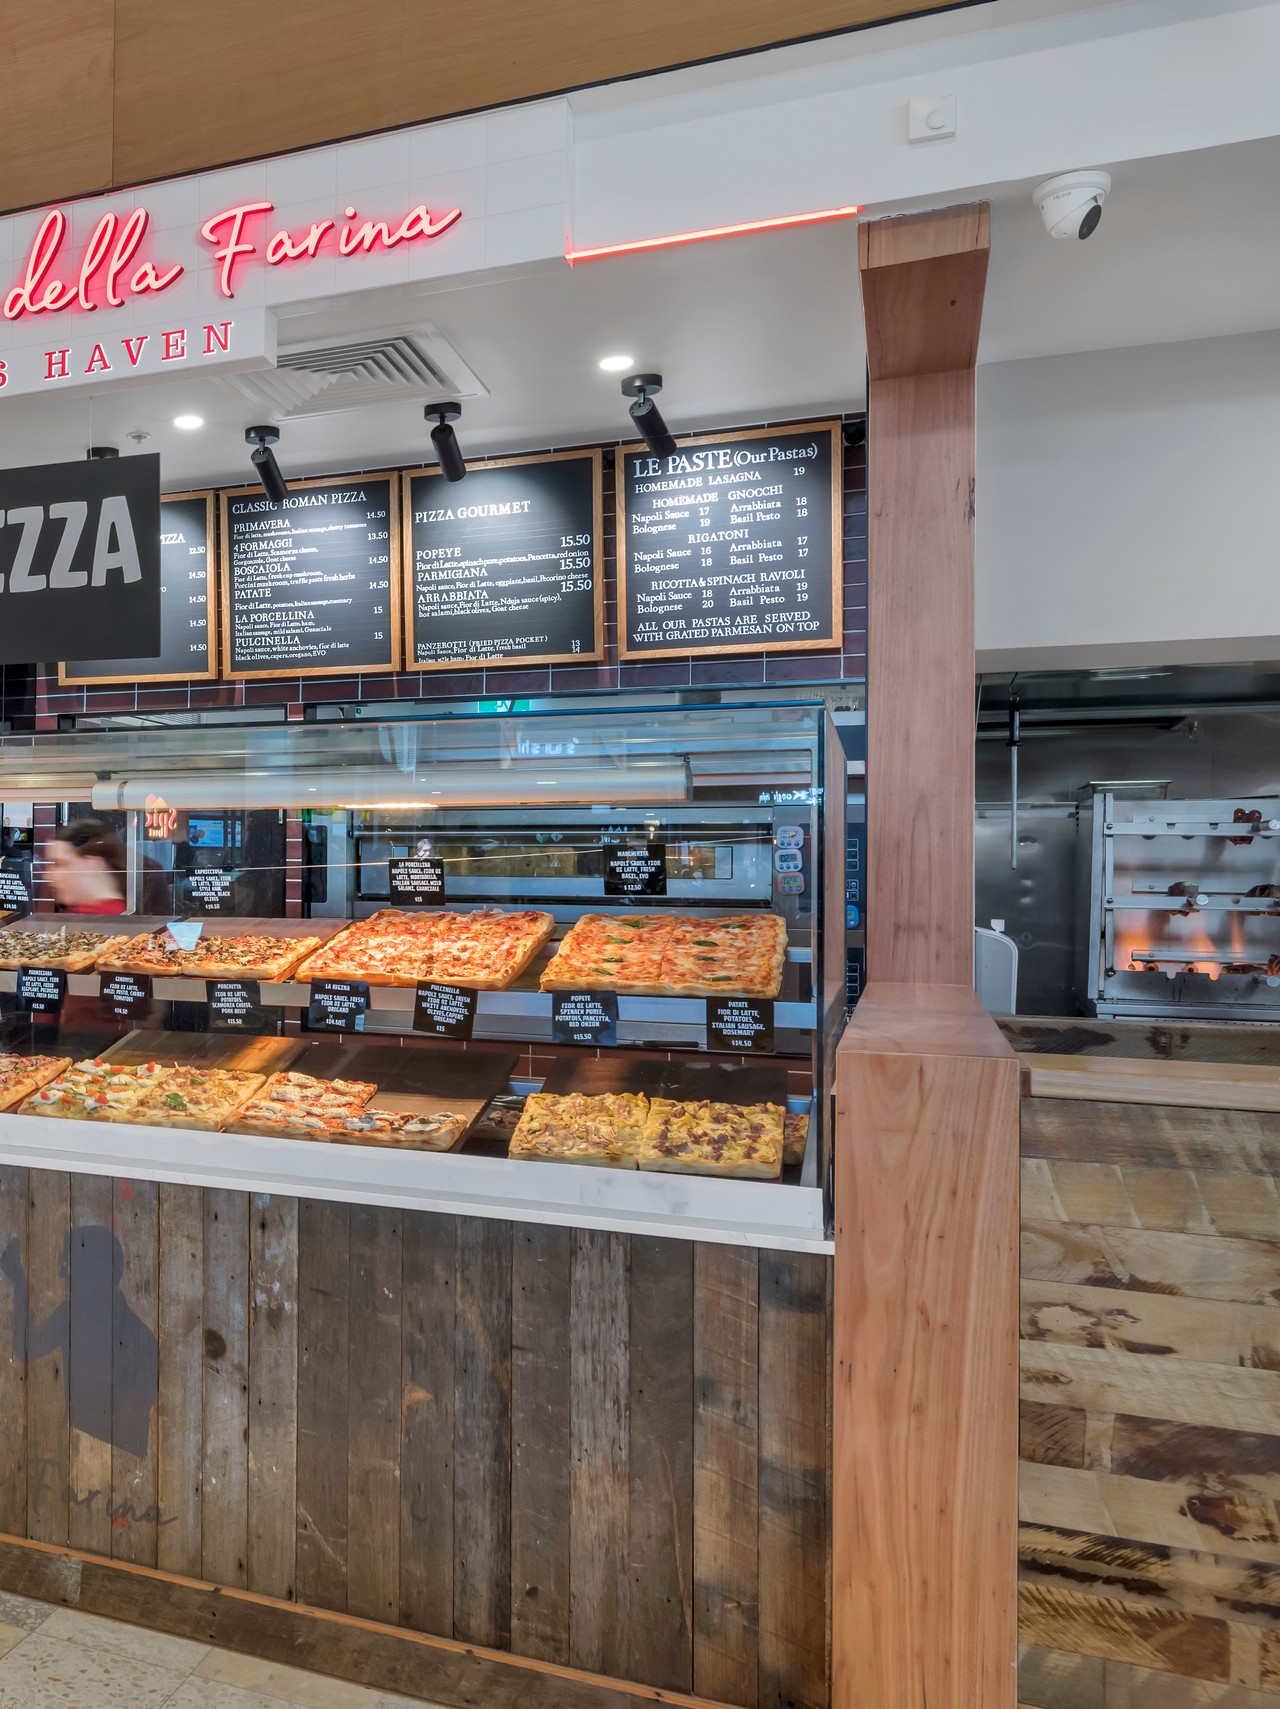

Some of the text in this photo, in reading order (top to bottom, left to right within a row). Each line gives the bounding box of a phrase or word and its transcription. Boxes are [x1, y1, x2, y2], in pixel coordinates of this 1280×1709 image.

[6, 207, 183, 320] della
[201, 202, 462, 298] Farina
[43, 321, 235, 382] HAVEN
[634, 443, 817, 478] LE PASTE (Our Pastas)
[635, 467, 805, 493] HOMEMADE LASAGNA 19
[232, 491, 367, 514] CLASSIC ROMAN PIZZA
[652, 485, 783, 508] HOMEMADE GNOCCHI
[415, 501, 530, 523] PIZZA GOURMET
[730, 501, 781, 512] Arrabbiata
[234, 511, 385, 532] PRIMAVERA 14.50
[632, 507, 709, 523] Napoli Sauce 17
[730, 509, 807, 524] Basil Pesto 18
[633, 523, 676, 534] Bolognese
[688, 529, 749, 544] RIGATONI
[160, 533, 185, 545] IZZA
[240, 538, 293, 551] FORMAGGI
[368, 532, 388, 540] 13.50
[416, 534, 590, 560] POPEYE 15.50
[729, 537, 808, 552] Arrabbiata 17
[634, 547, 711, 562] Napoli Sauce 16
[730, 549, 808, 565] Basil Pesto 17
[234, 556, 388, 576] BOSCAIOLA 14.50
[418, 558, 590, 581] PARMIGIANA 15.50
[634, 562, 679, 573] Bolognese
[760, 569, 805, 581] RAVIOLI
[234, 581, 388, 599] PATATE 14.50
[418, 580, 592, 603] ARRABBIATA 15.50
[637, 590, 712, 603] Napoli Sauce 18
[729, 582, 807, 596] Arrabbiata 19
[730, 593, 808, 607] Basil Pesto 19
[637, 603, 683, 614] Bolognese
[235, 615, 247, 623] LA
[250, 611, 315, 622] PORCELLINA
[638, 611, 810, 631] ALL OUR PASTAS ARE SERVED
[633, 621, 819, 642] WITH GRATED PARMESAN ON TOP
[235, 636, 300, 646] PULCINELLA
[418, 641, 466, 650] PANZEROTTI
